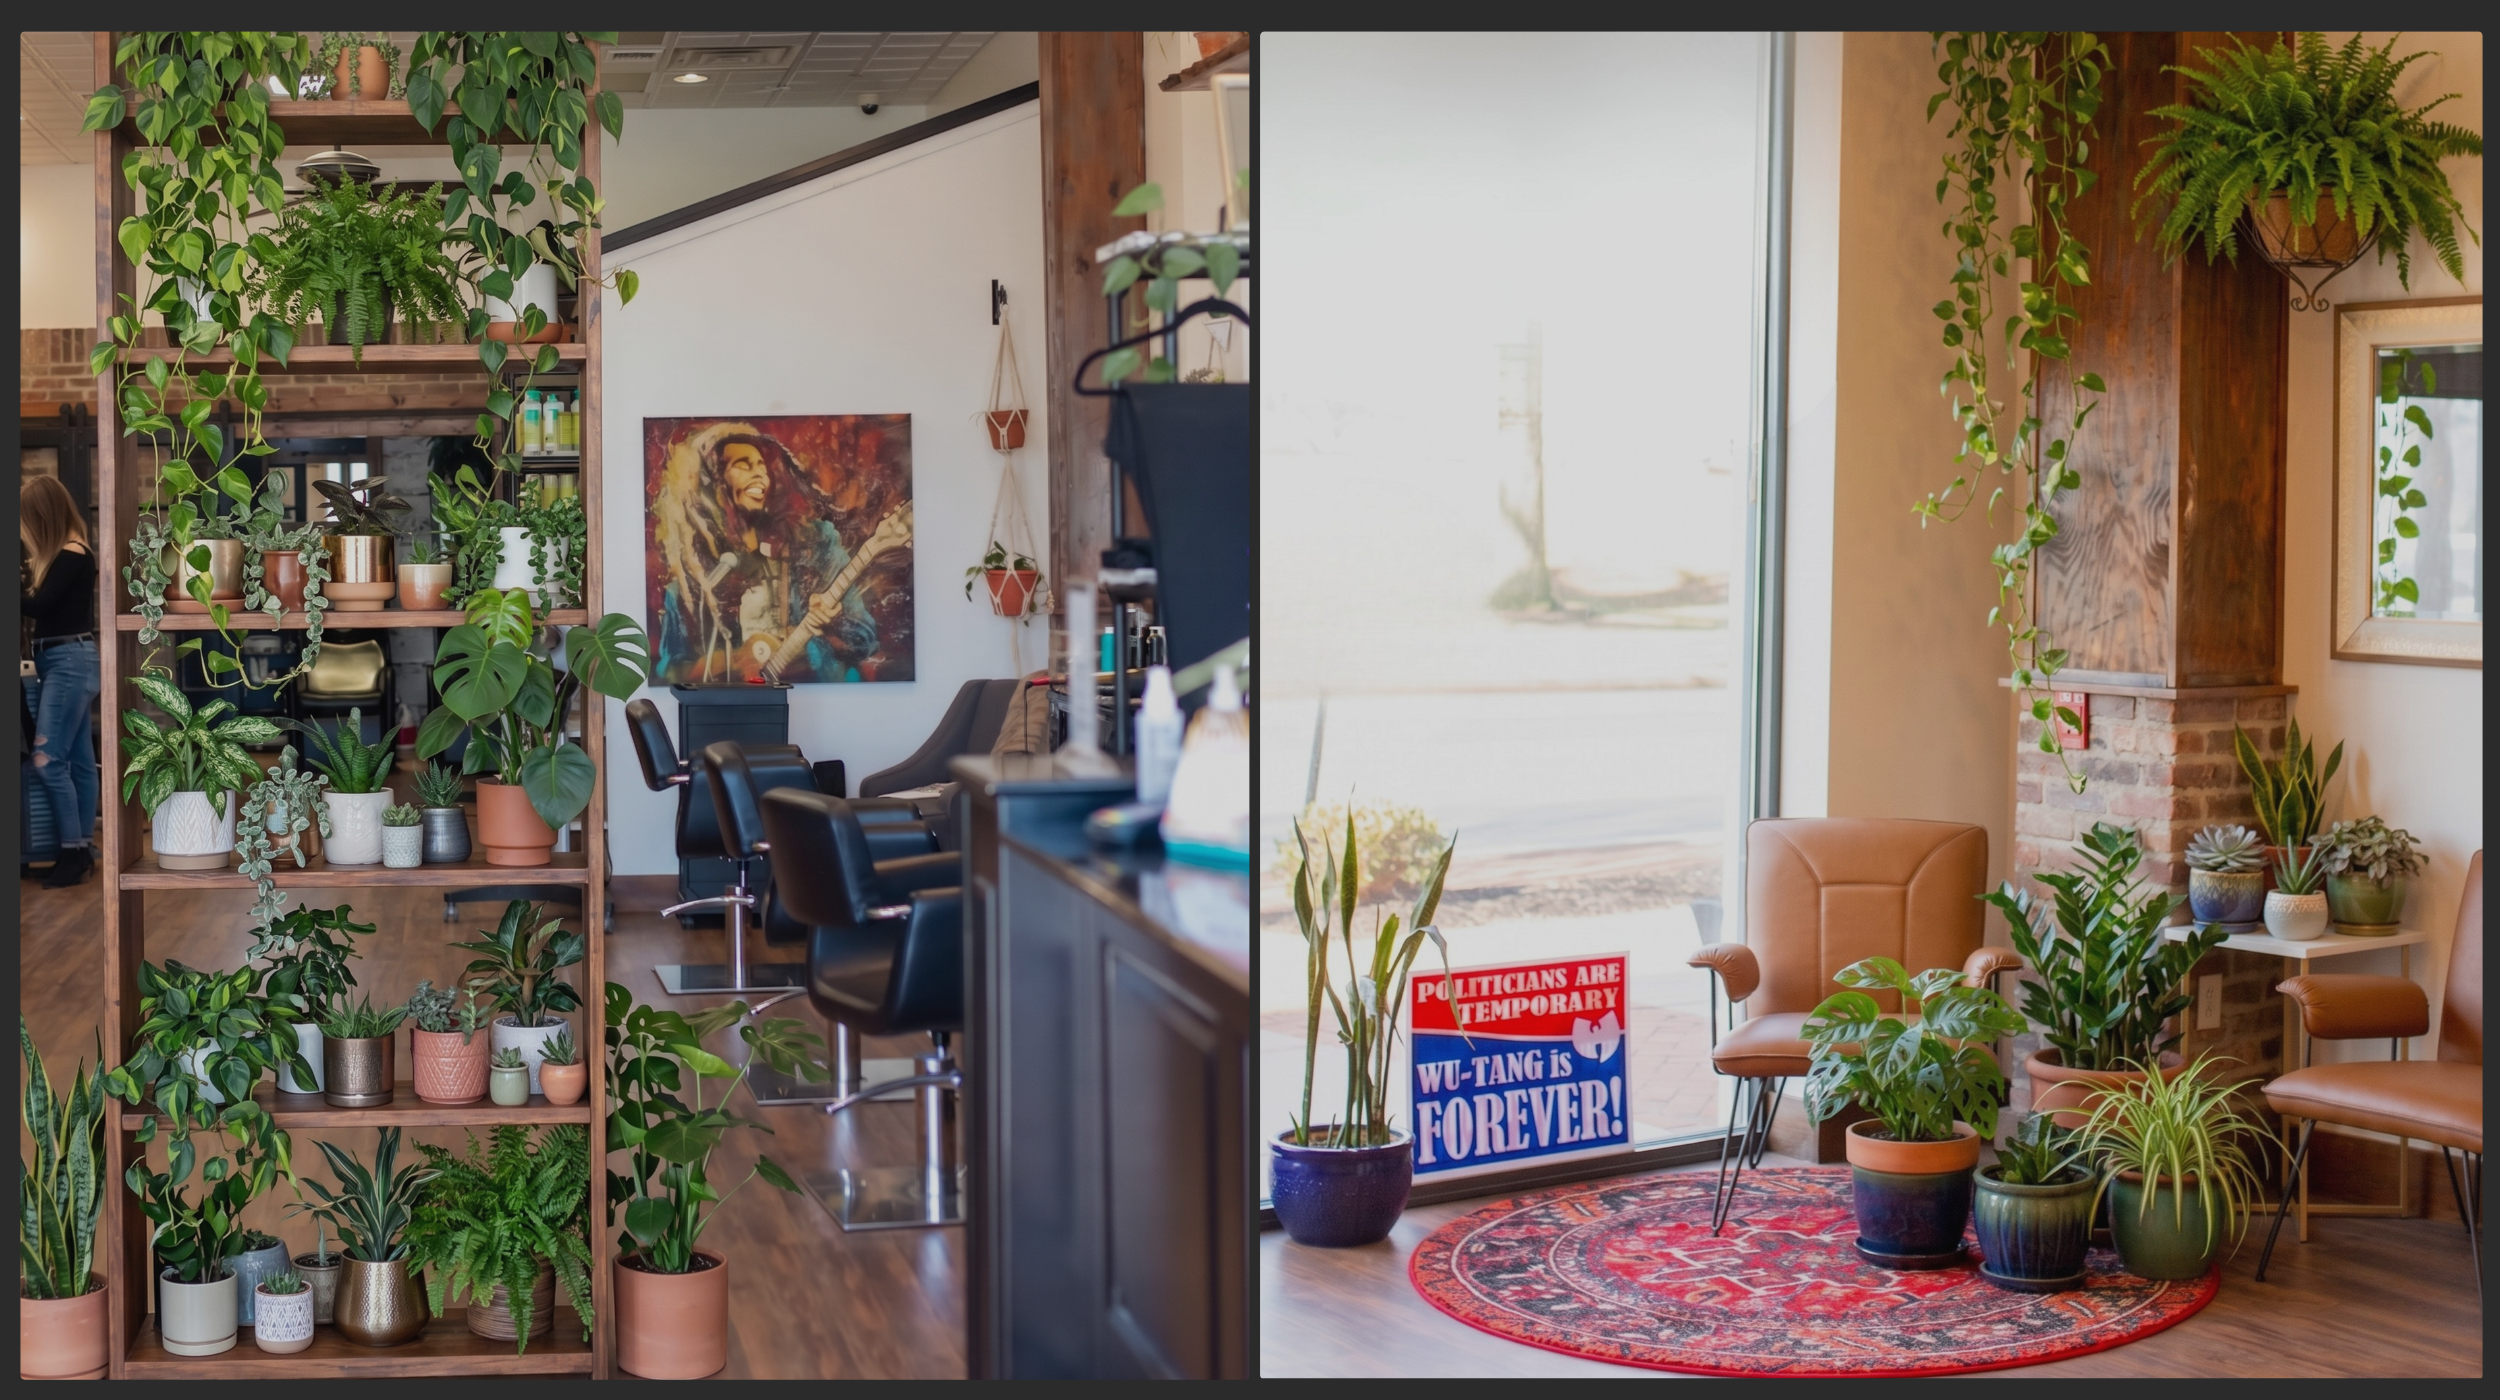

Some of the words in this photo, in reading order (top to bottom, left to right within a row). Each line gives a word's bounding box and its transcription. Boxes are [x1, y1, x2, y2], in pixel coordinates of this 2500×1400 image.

[1417, 967, 1567, 1003] POLITICIANS
[1574, 962, 1621, 986] ARE
[1457, 987, 1619, 1025] TEMPORARY
[1416, 1049, 1544, 1094] WU-TANG
[1549, 1049, 1573, 1078] is
[1416, 1076, 1623, 1165] FOREVER!
